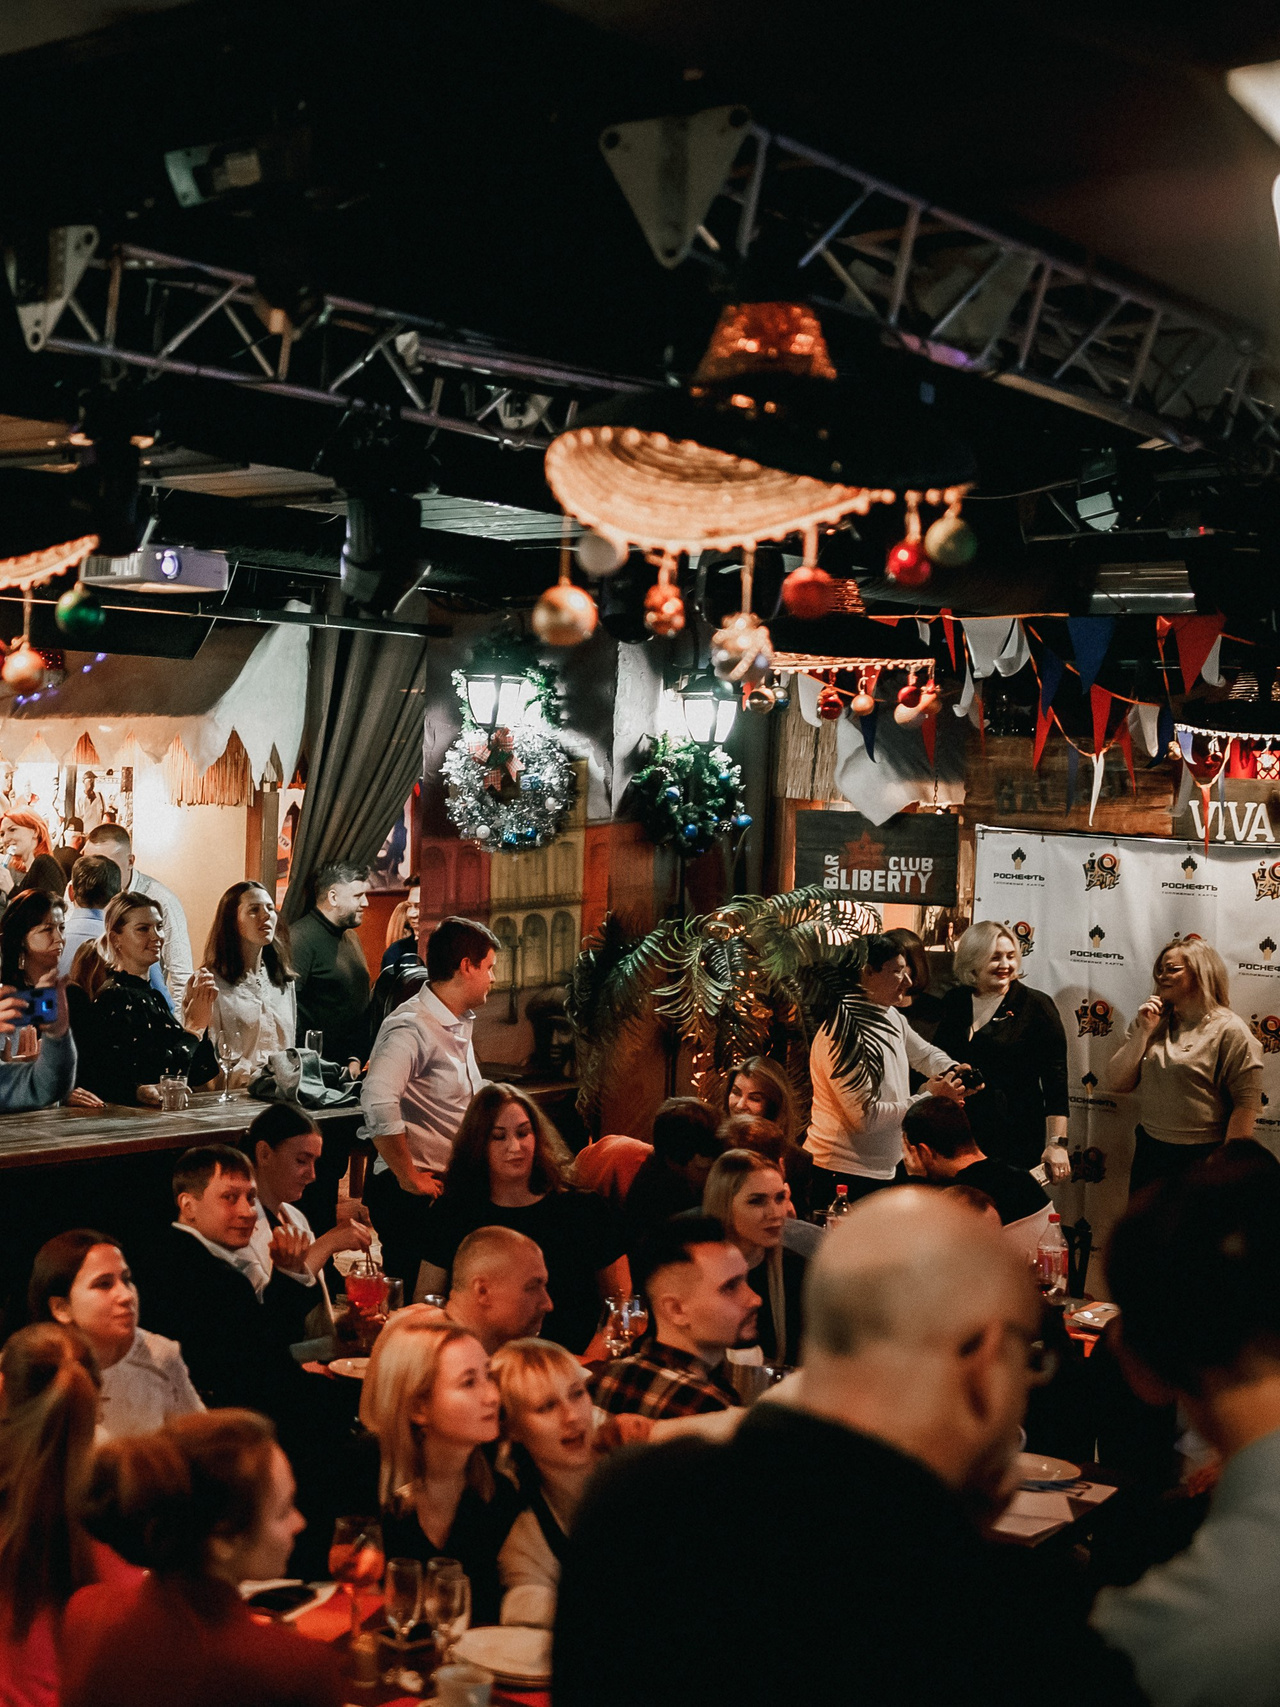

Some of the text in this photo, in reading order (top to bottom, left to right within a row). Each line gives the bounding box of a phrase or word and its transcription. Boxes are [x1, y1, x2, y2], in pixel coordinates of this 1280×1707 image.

[1188, 800, 1276, 843] VIVA
[888, 856, 934, 872] CLUB
[823, 854, 840, 890] BAR
[993, 872, 1045, 881] РОСНЕФТЬ
[840, 868, 933, 894] LIBERTY
[1161, 882, 1218, 891] РОСНЕФТЬ
[1070, 950, 1124, 960] РОСНЕФТЬ
[1069, 1096, 1117, 1107] ОСНЕФТЬ
